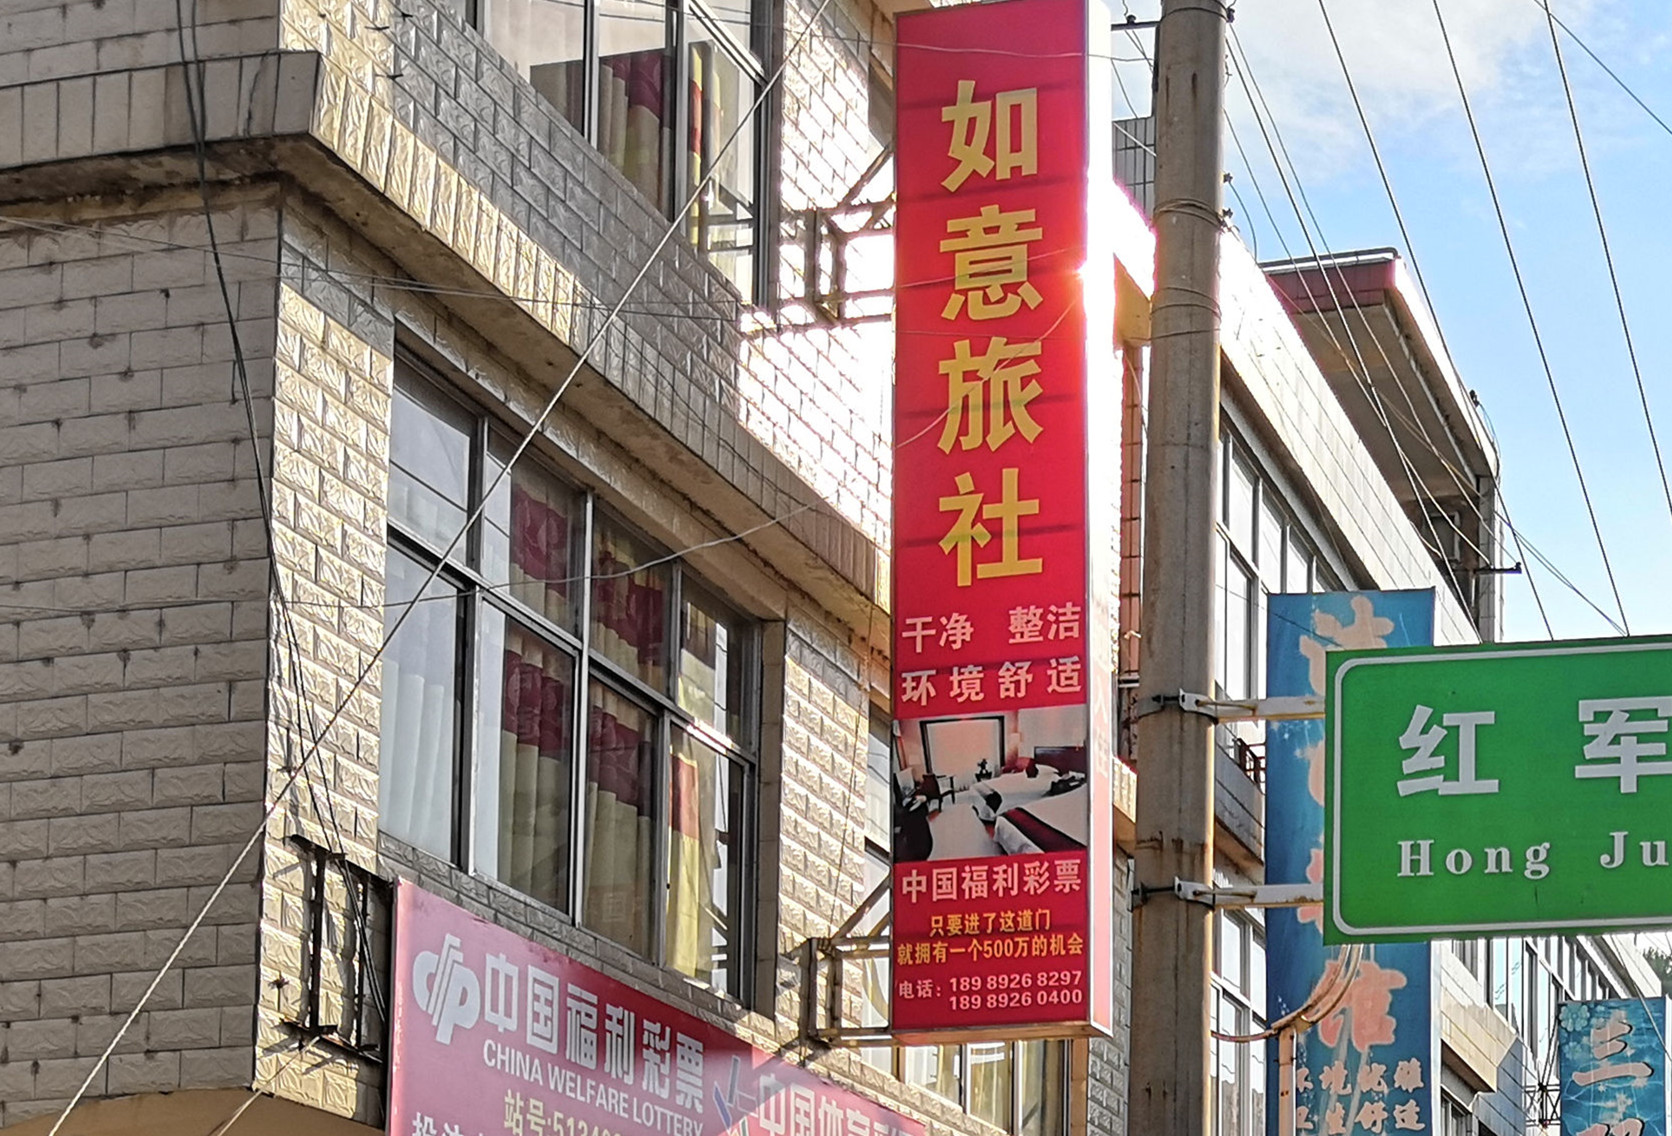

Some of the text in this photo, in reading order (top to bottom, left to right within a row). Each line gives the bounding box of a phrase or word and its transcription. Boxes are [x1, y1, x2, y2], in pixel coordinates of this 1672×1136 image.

[937, 80, 1043, 588] 如意旅社
[901, 602, 1081, 653] 干净 整洁
[900, 656, 1082, 706] 环境舒适
[902, 859, 1082, 903] 中国福利彩票
[1397, 839, 1551, 879] Hong
[929, 908, 1051, 938] 只要进了这道门
[897, 932, 1083, 965] 就拥有一个500万的机会
[949, 976, 982, 992] 189
[986, 973, 1033, 990] 8926
[1037, 971, 1082, 987] 8297
[949, 989, 1083, 1010] 189 8926 0400
[484, 952, 703, 1113] 中国福利彩票
[483, 1039, 544, 1086] CHINA
[548, 1063, 629, 1119] WELFARE
